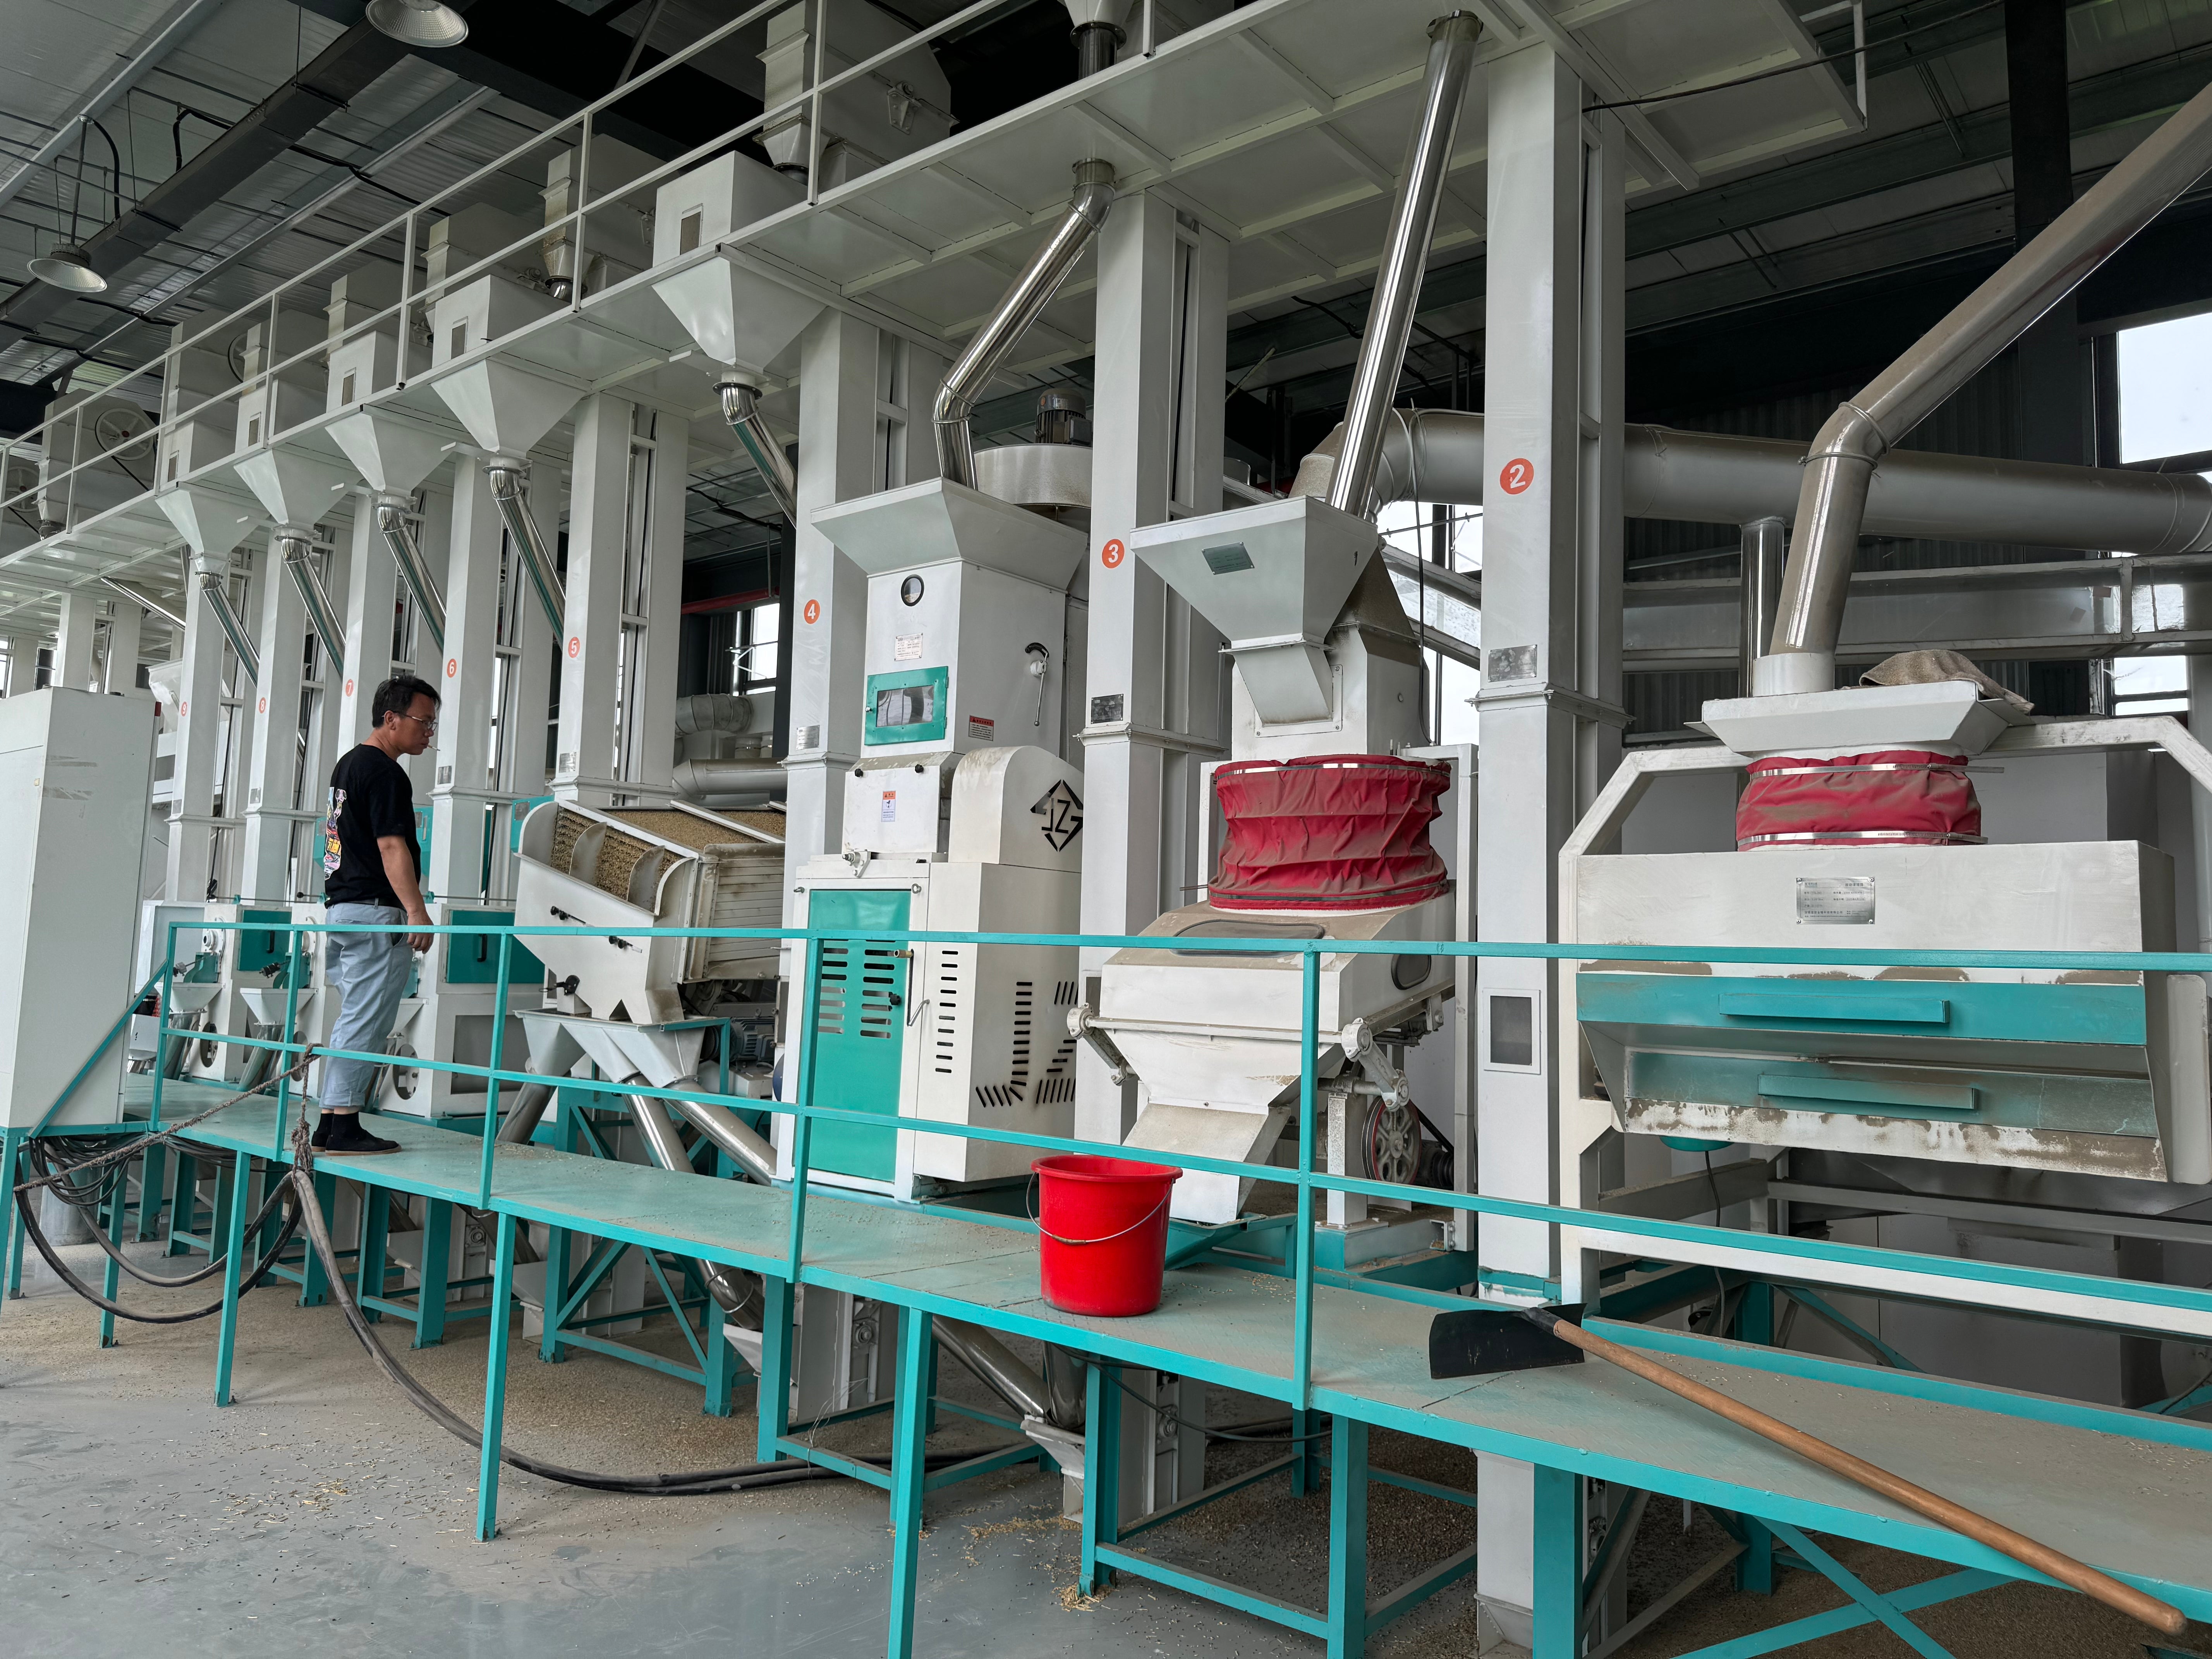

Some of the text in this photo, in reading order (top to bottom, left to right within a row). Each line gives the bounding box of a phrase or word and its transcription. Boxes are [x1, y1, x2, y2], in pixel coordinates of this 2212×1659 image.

[1510, 464, 1525, 489] 2
[1108, 544, 1118, 563] 3
[807, 604, 816, 619] 4
[571, 641, 577, 654] 5
[450, 662, 454, 675] 6
[348, 682, 352, 694] 7
[182, 704, 187, 714] 9
[260, 700, 265, 711] 8
